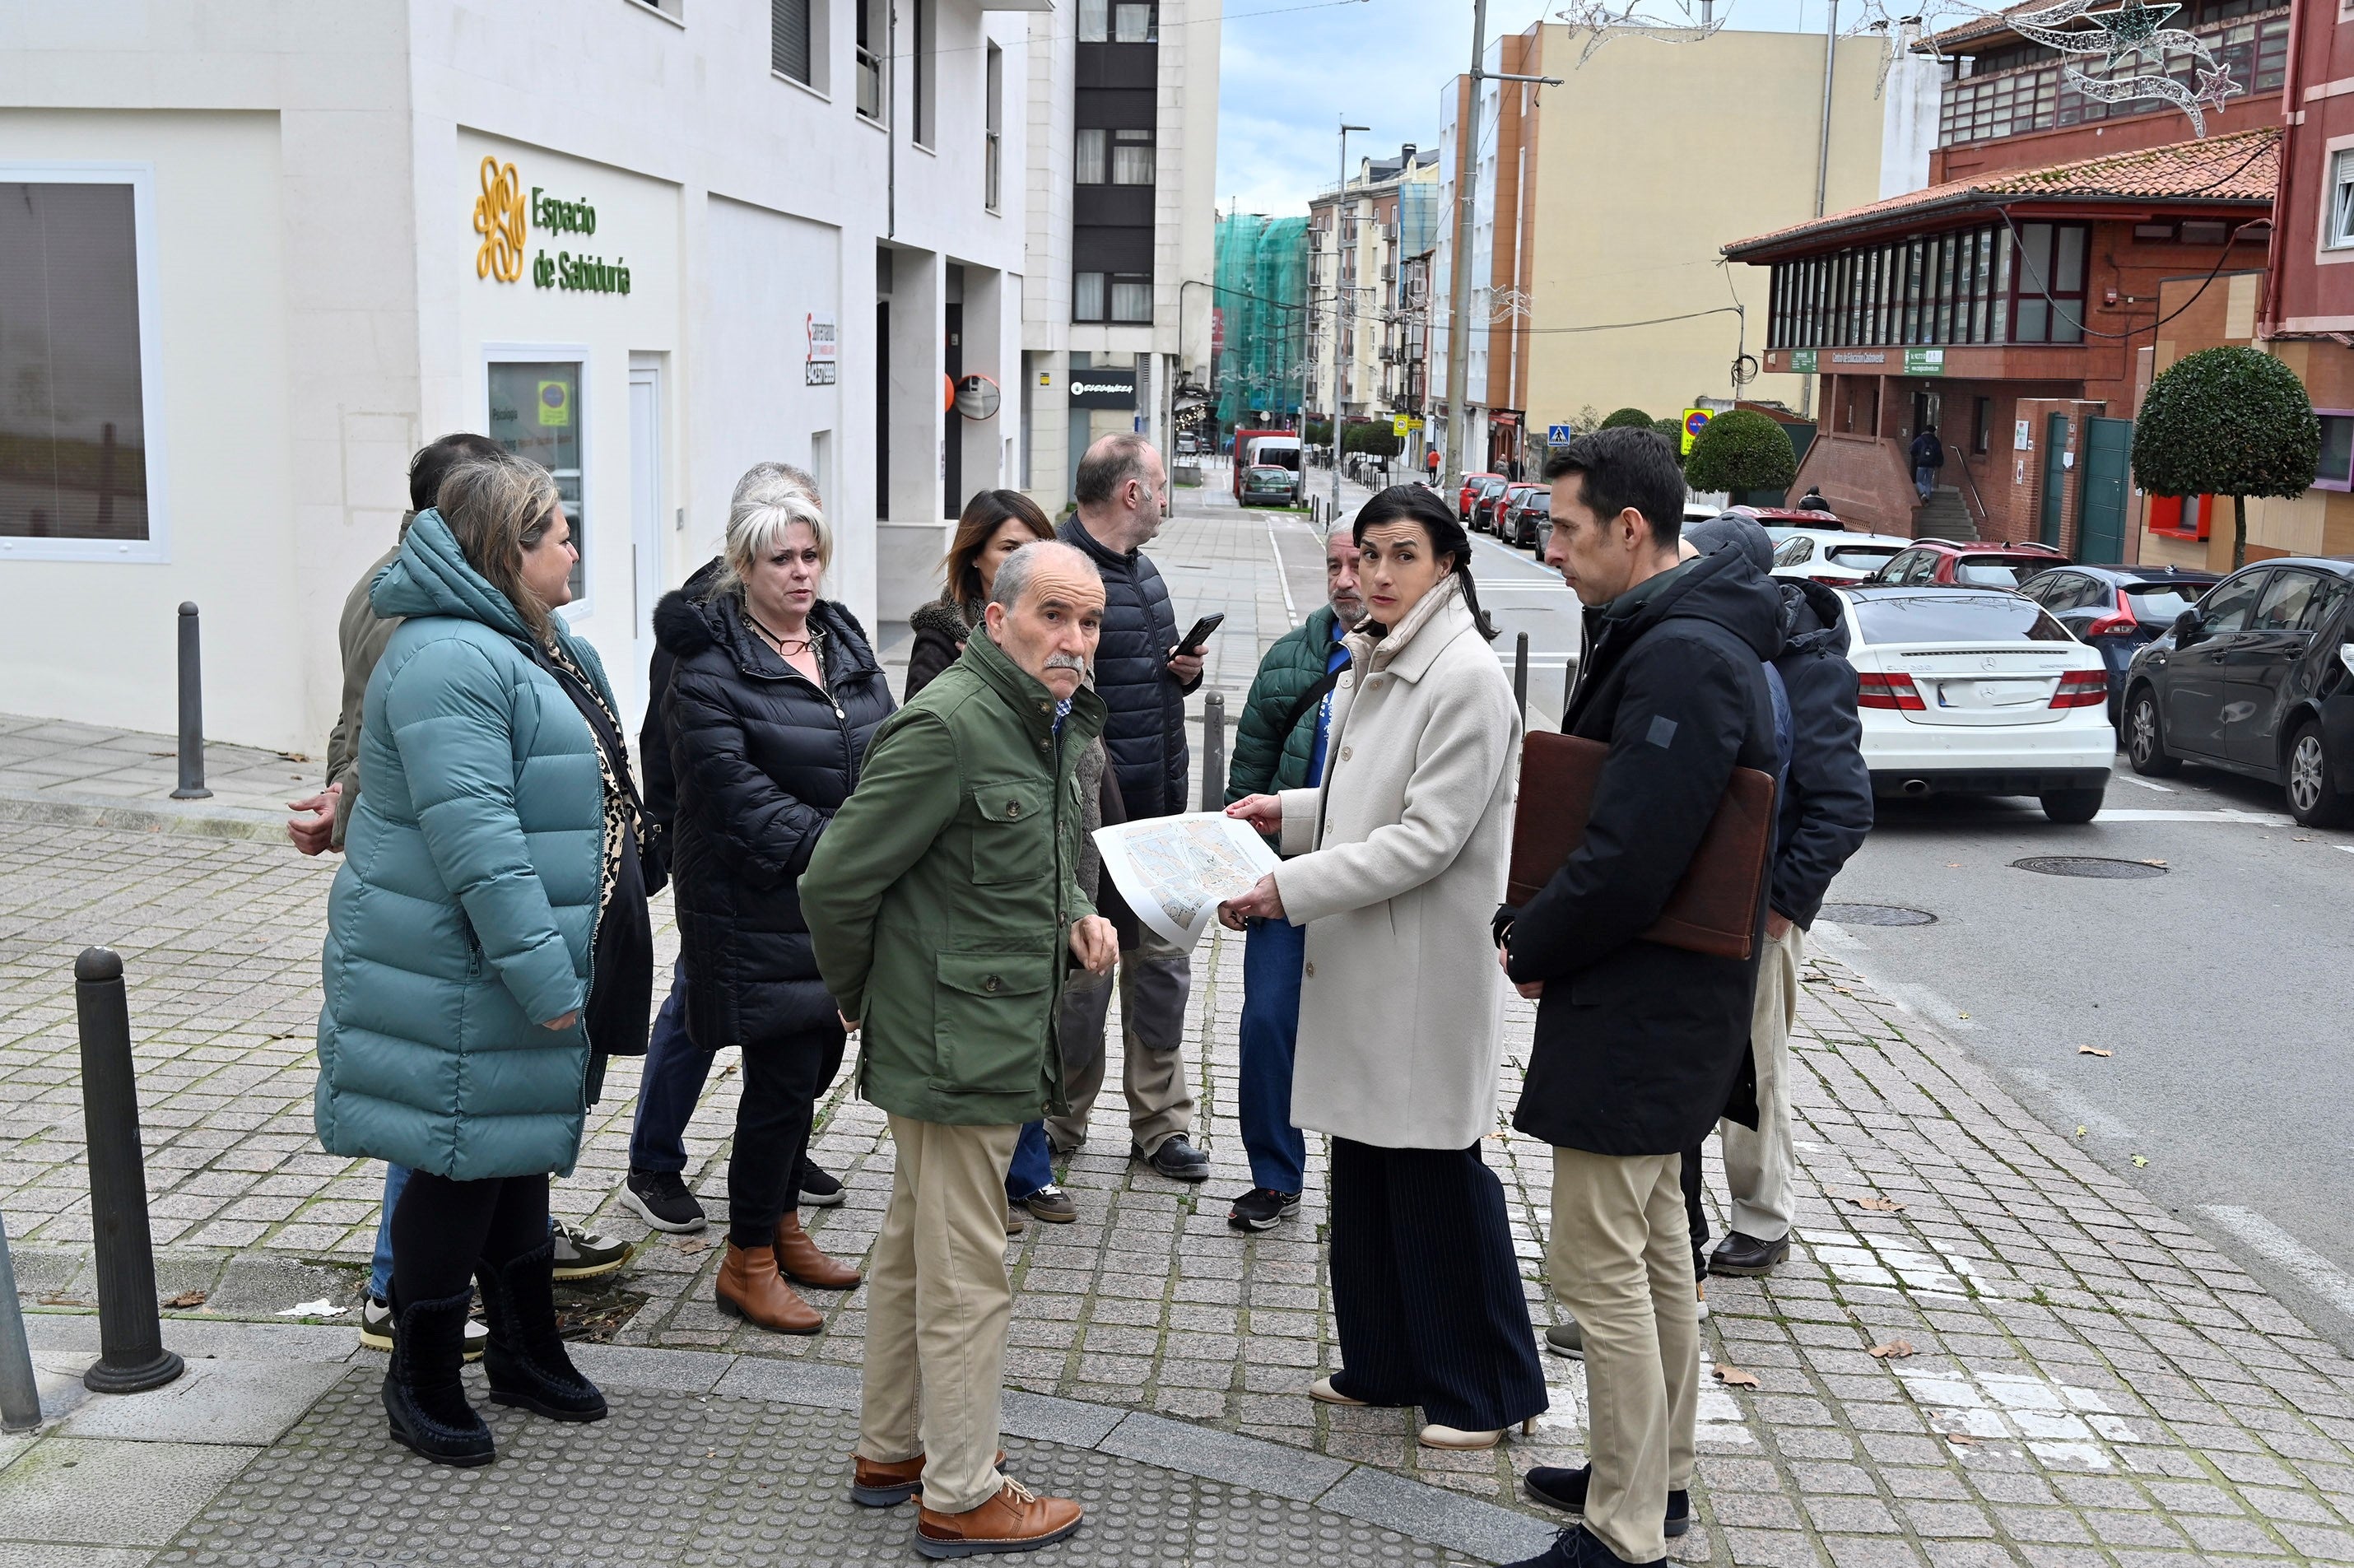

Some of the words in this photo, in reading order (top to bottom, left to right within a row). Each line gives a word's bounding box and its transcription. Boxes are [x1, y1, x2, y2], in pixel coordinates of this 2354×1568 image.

[532, 186, 596, 237] Espacio
[533, 249, 556, 288] de
[558, 250, 630, 294] Sabiduría
